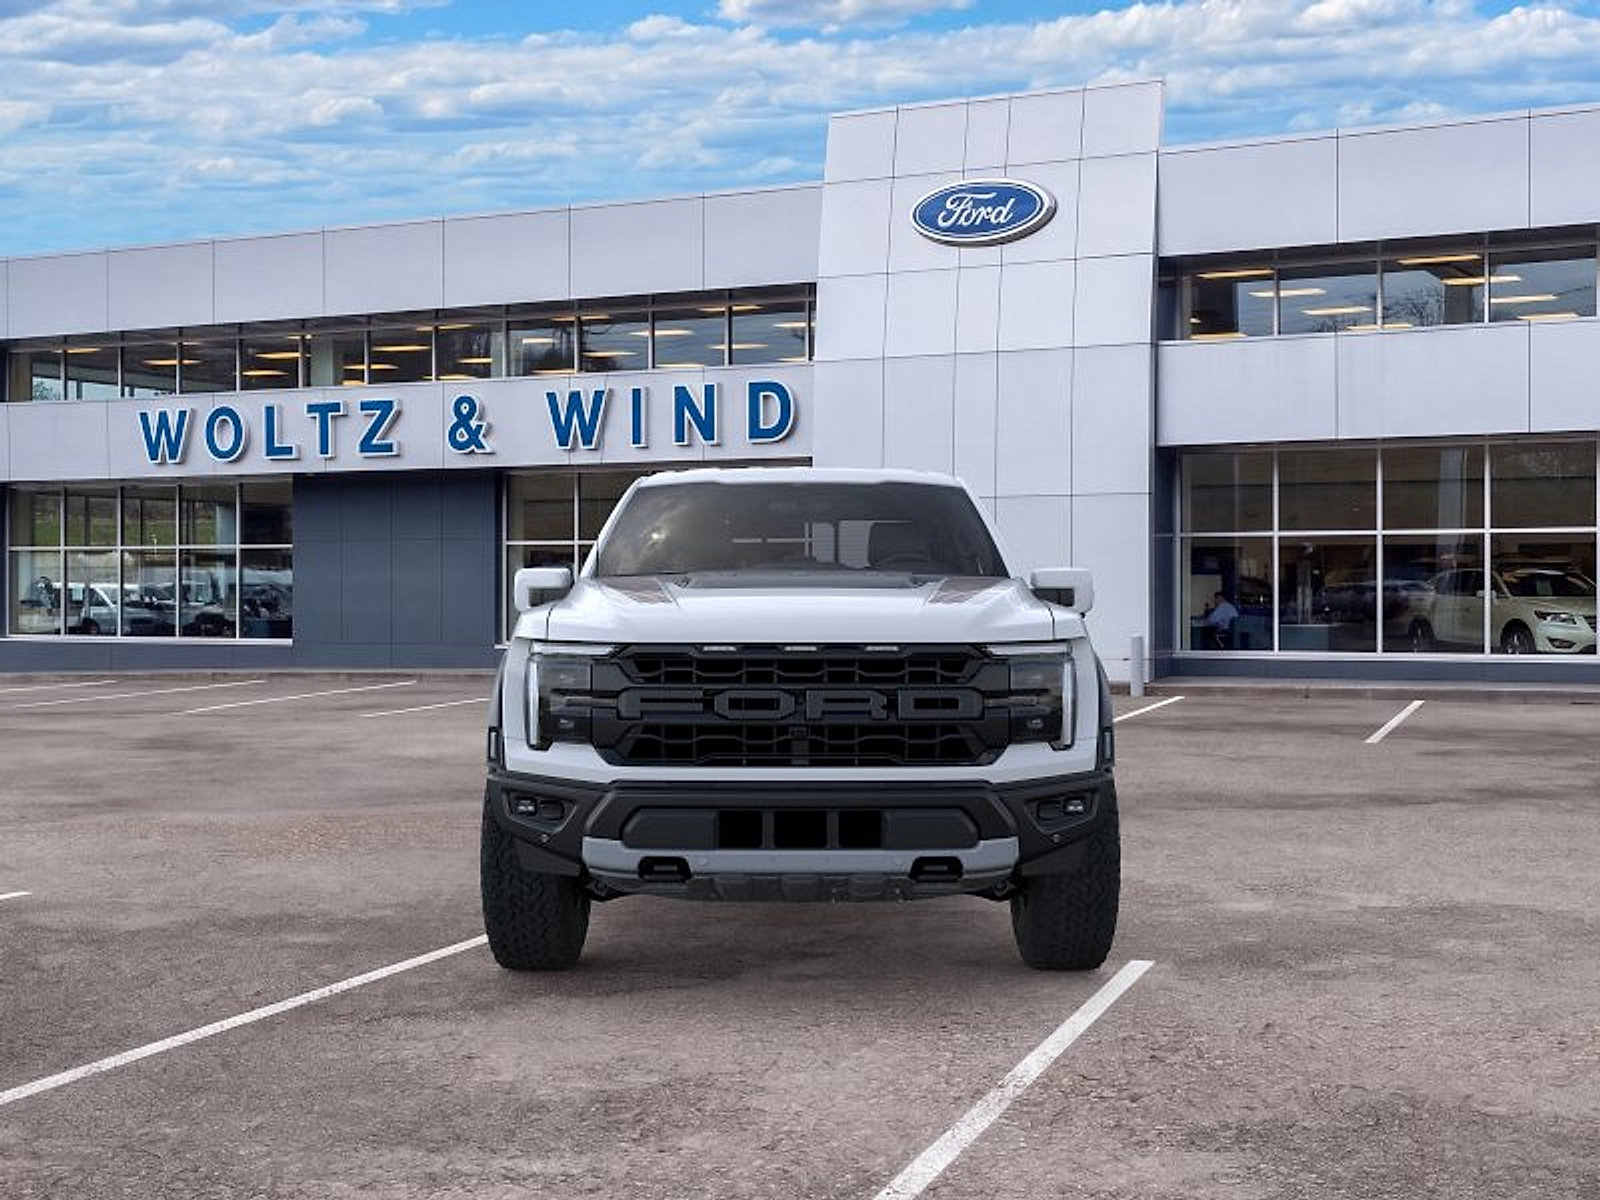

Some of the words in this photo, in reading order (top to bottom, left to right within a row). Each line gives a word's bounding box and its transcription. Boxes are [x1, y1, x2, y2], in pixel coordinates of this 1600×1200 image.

[937, 192, 1015, 227] Ford
[138, 399, 399, 464] WOLTZ
[447, 394, 491, 454] &
[545, 380, 795, 450] WIND
[617, 688, 984, 720] FORD
